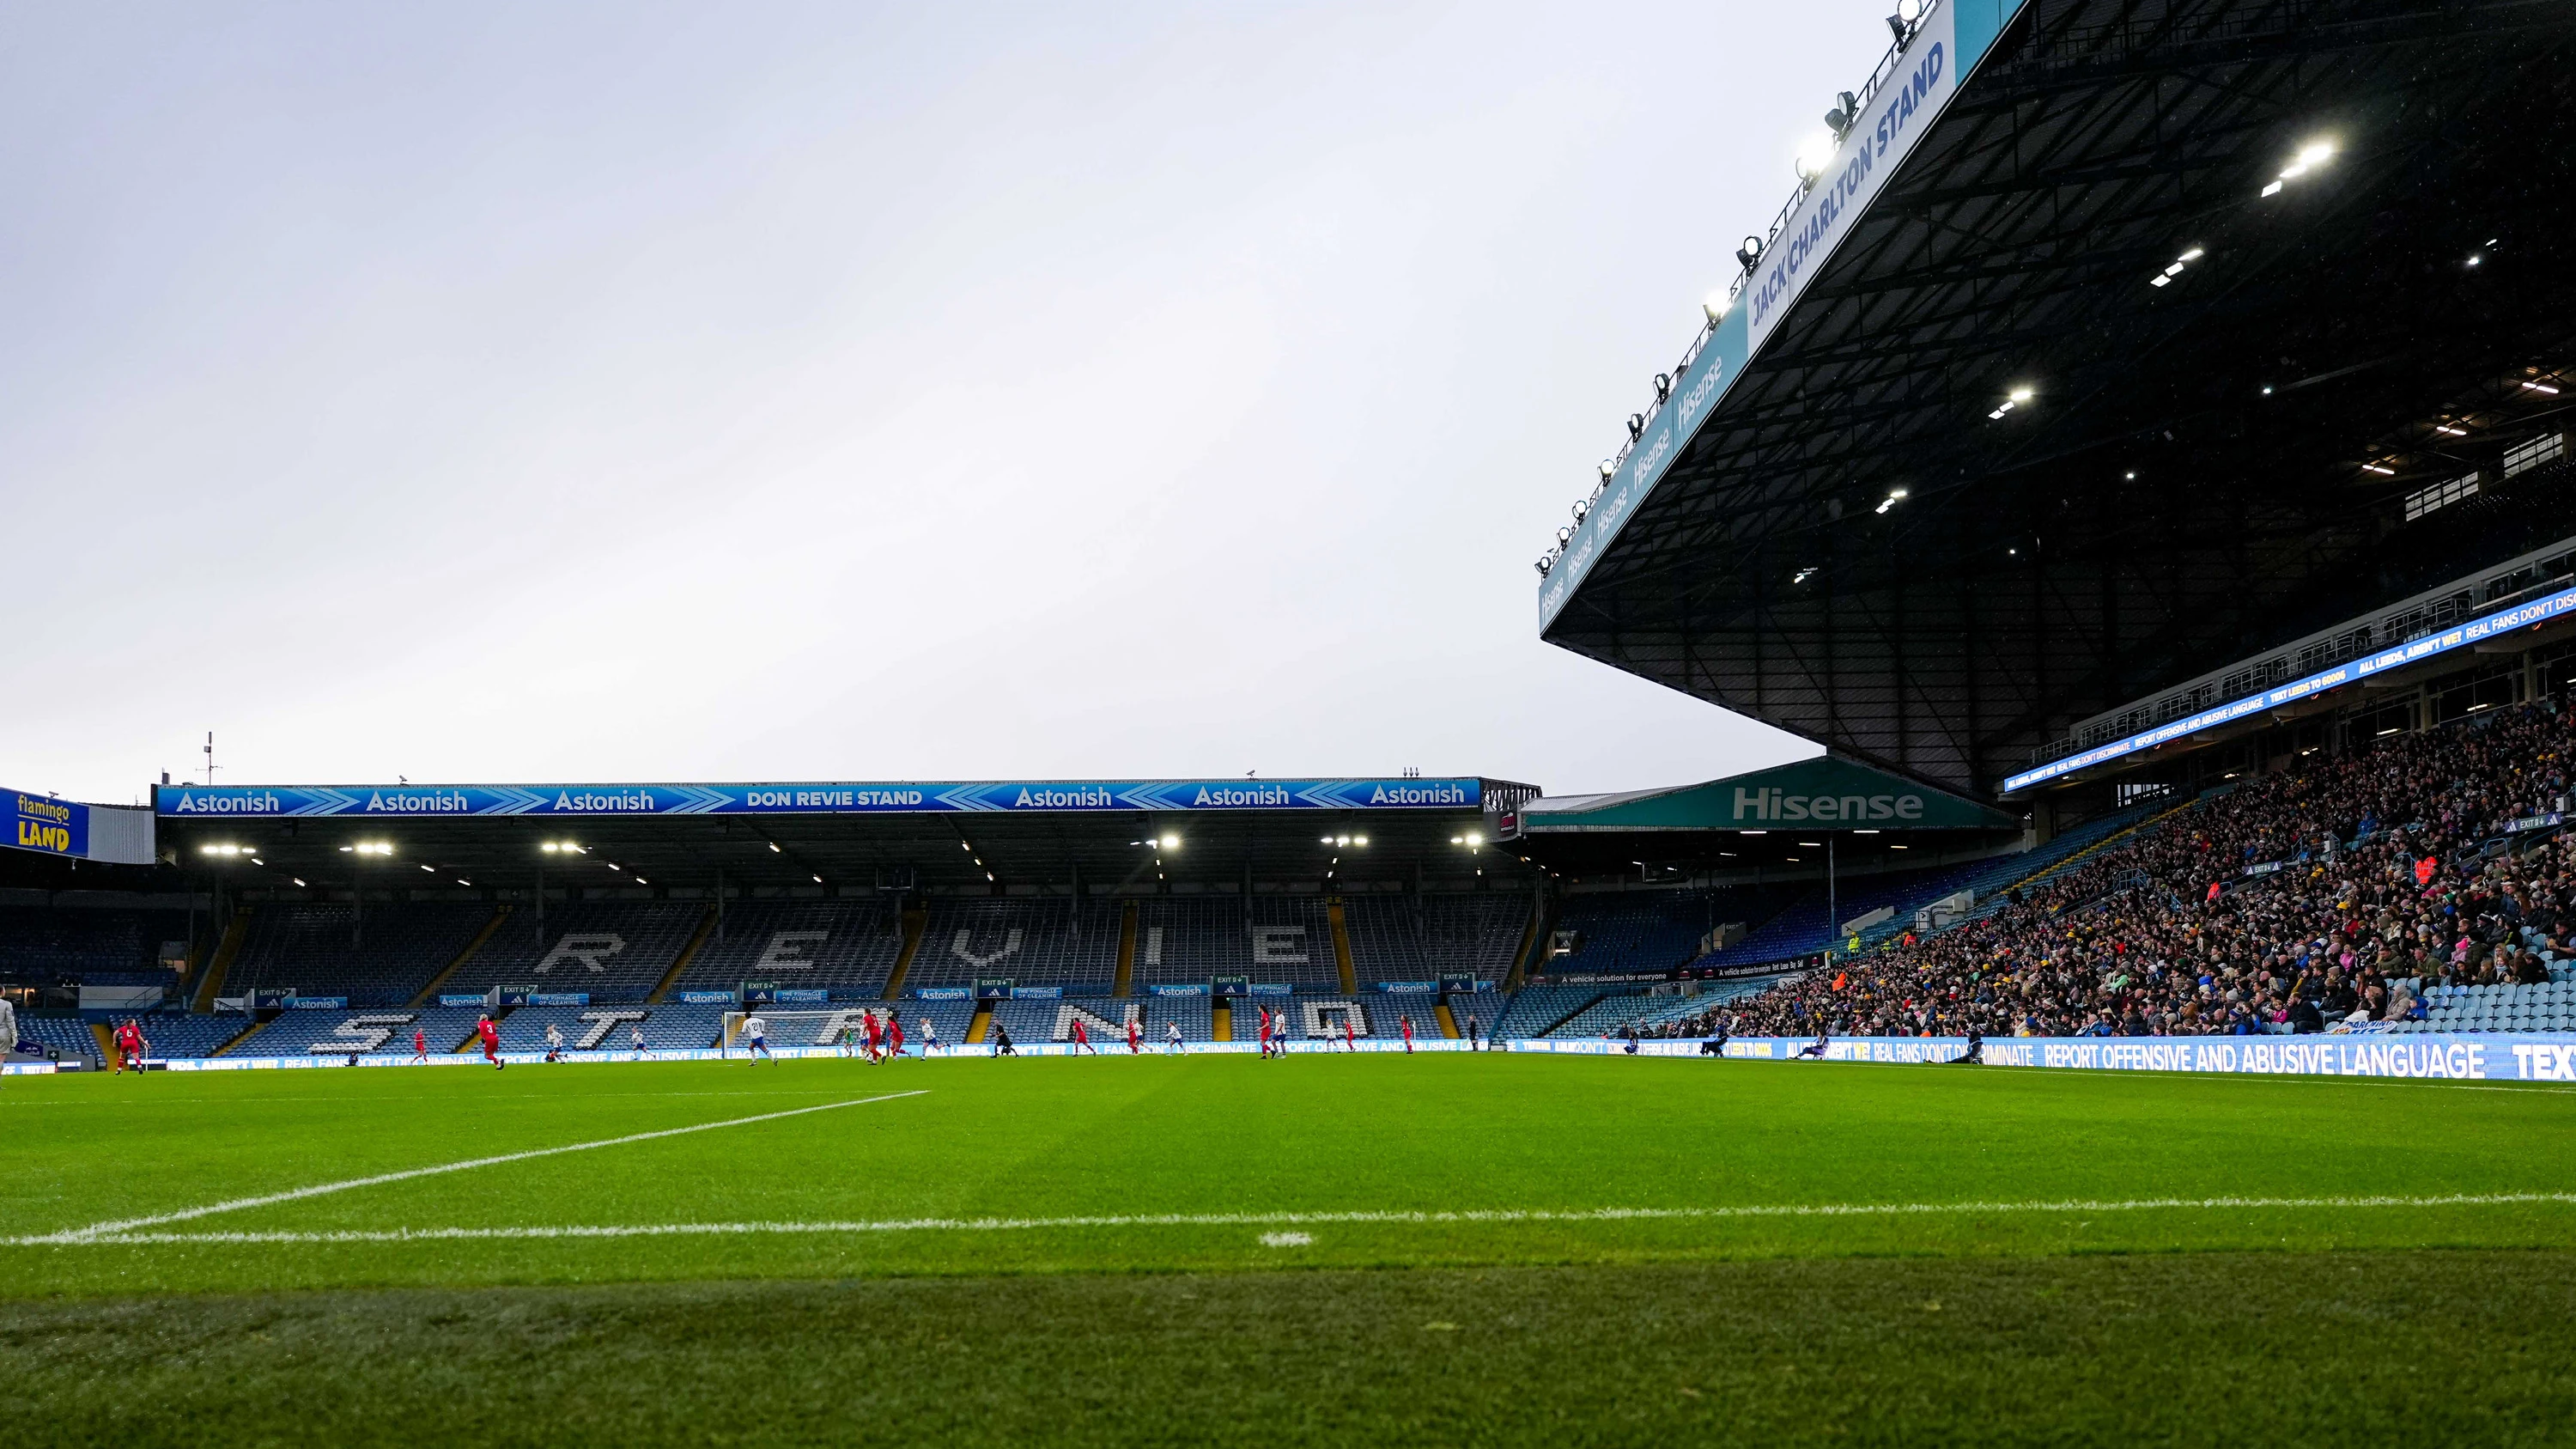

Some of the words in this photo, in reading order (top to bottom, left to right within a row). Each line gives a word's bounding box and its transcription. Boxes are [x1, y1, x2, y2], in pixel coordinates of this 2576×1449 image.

[1753, 254, 1788, 327] JACK
[1789, 135, 1872, 277] CHARLTON
[1876, 41, 1943, 158] STAND
[1679, 356, 1722, 431] Hisense
[1635, 428, 1669, 490] Hisense
[1597, 486, 1627, 539] Hisense
[1568, 535, 1592, 583] Hisense
[1541, 576, 1564, 618] Hisense
[2359, 661, 2374, 675] ALL
[2375, 652, 2406, 670] LEEDS,
[2406, 637, 2440, 660] AREN'T
[2441, 630, 2463, 648] WE?
[2465, 624, 2490, 640] REAL
[2491, 615, 2518, 634] FANS
[2519, 602, 2553, 625] DON'T
[2081, 752, 2096, 764] DON'T
[2096, 741, 2130, 761] DISCRIMINATE
[2135, 733, 2155, 747] REPORT
[2156, 724, 2187, 741] OFFENSIVE
[2187, 717, 2201, 731] AND
[2201, 709, 2228, 727] ABUSIVE
[2228, 698, 2264, 717] LANGUAGE
[2269, 690, 2287, 703] TEXT
[2287, 681, 2310, 697] LEEDS
[2310, 678, 2321, 691] TO
[2321, 669, 2346, 686] 60006
[176, 790, 279, 813] Astonish
[366, 789, 468, 813] Astonish
[553, 788, 654, 812] Astonish
[747, 791, 792, 807] DON
[796, 791, 854, 807] REVIE
[857, 789, 923, 806] STAND
[1015, 786, 1112, 807] Astonish
[1194, 784, 1290, 806] Astonish
[1370, 782, 1465, 805] Astonish
[1733, 787, 1924, 820] Hisense
[18, 794, 70, 824] flamingo
[2520, 819, 2534, 829] EXIT
[18, 820, 70, 852] LAND
[1388, 983, 1430, 994] Astonish
[1569, 975, 1595, 983] vehicle
[1596, 974, 1625, 983] solution
[1625, 973, 1636, 982] for
[1637, 972, 1668, 981] everyone
[441, 996, 483, 1008] Astonish
[683, 992, 729, 1003] Astonish
[920, 989, 965, 1000] Astonish
[1158, 986, 1201, 996] Astonish
[293, 998, 338, 1010] Astonish
[126, 1029, 132, 1038] 6
[487, 1024, 493, 1033] 3
[751, 1022, 759, 1031] 21
[801, 1049, 837, 1057] LEEDS
[1042, 1045, 1066, 1056] WE?
[1380, 1042, 1404, 1052] AND
[1575, 1041, 1605, 1053] DON'T
[284, 1056, 319, 1068] REAL
[320, 1056, 350, 1068] FANS
[1874, 1042, 1895, 1062] REAL
[1896, 1042, 1920, 1063] FANS
[1922, 1043, 1953, 1064] DON'T
[2044, 1044, 2099, 1068] REPORT
[2103, 1044, 2191, 1072] OFFENSIVE
[2196, 1044, 2237, 1073] AND
[2241, 1044, 2334, 1075] ABUSIVE
[2341, 1044, 2486, 1079] LANGUAGE
[2512, 1044, 2576, 1081] TEX
